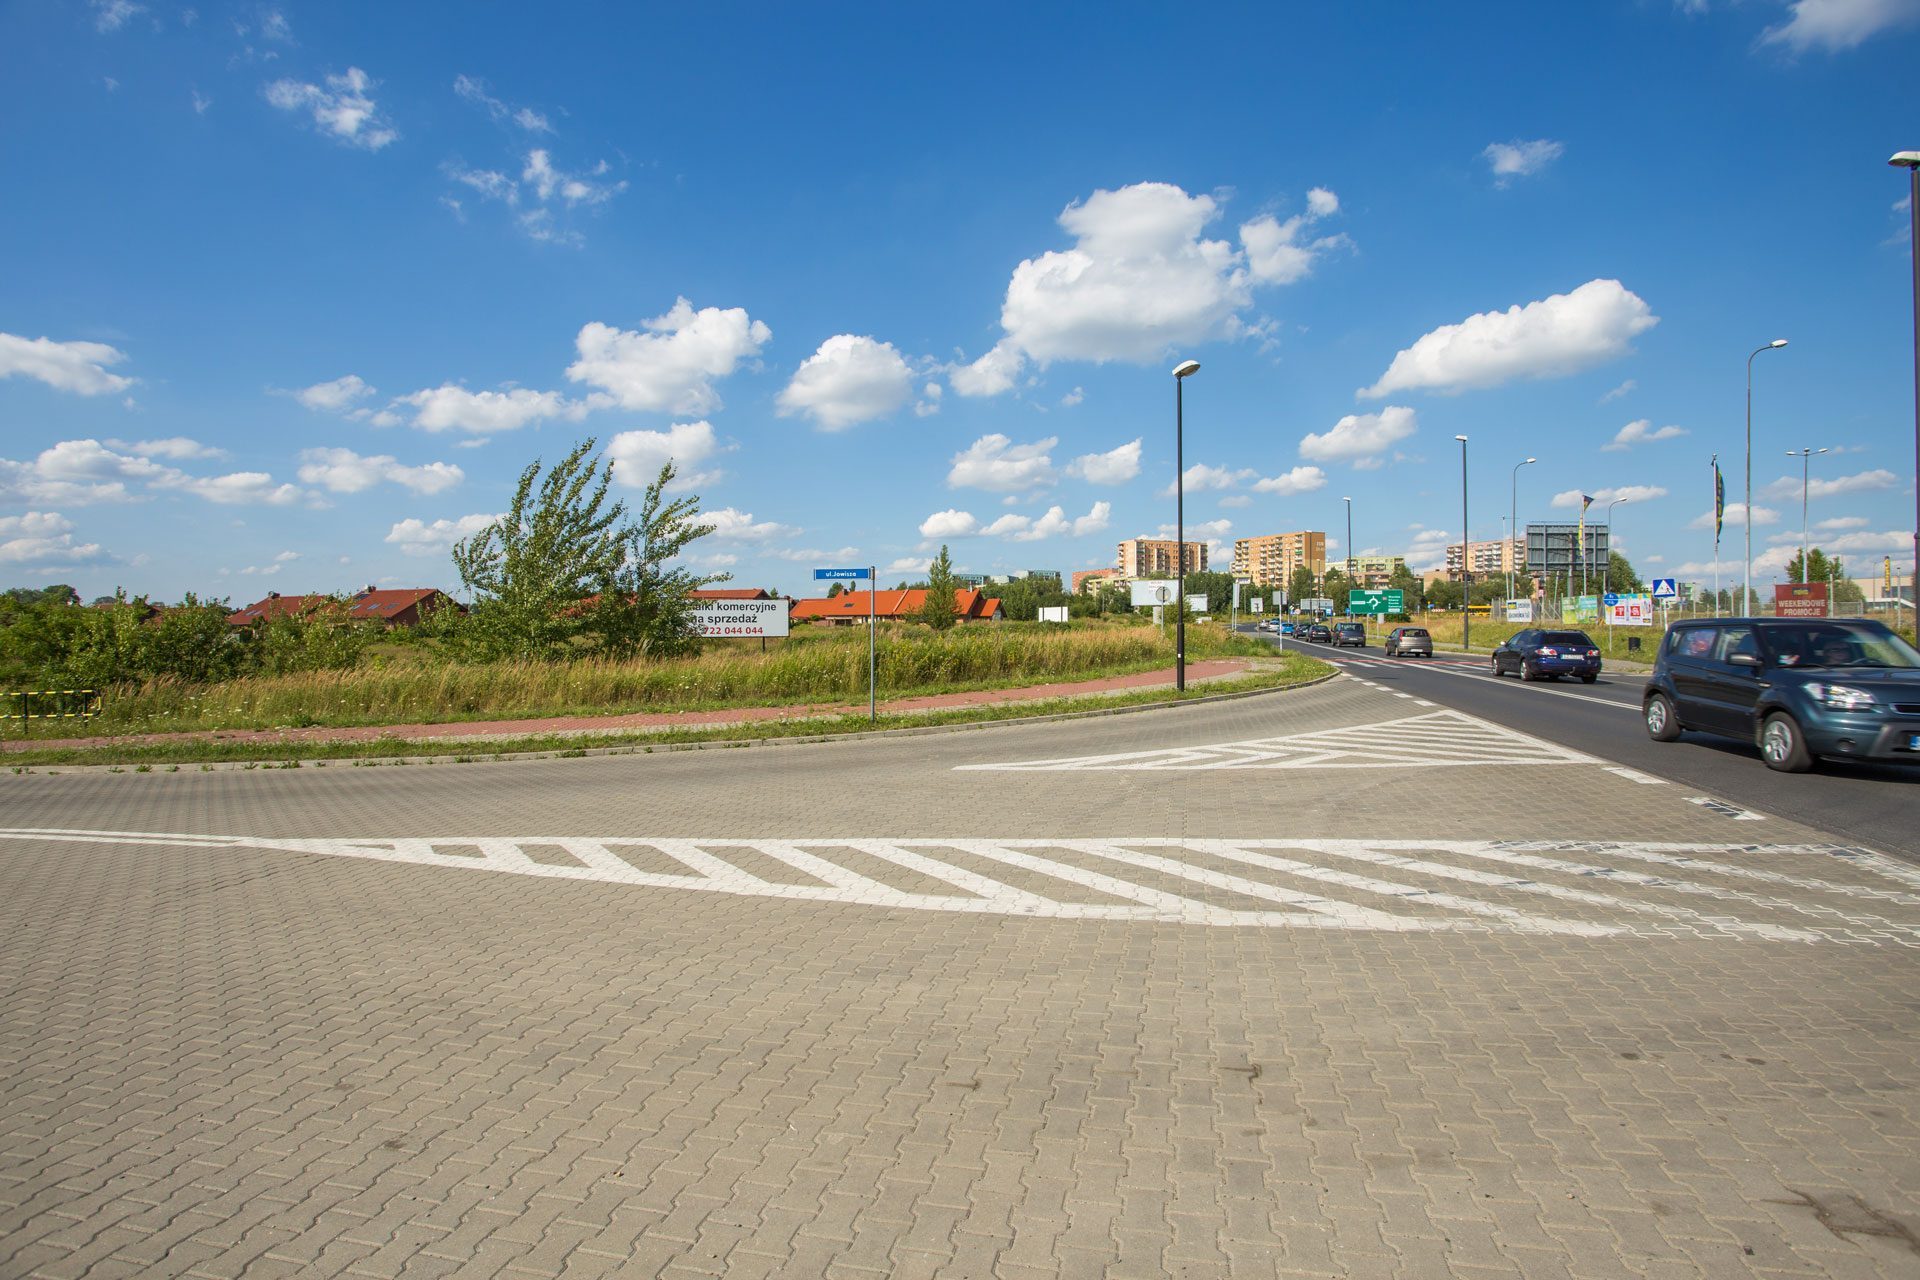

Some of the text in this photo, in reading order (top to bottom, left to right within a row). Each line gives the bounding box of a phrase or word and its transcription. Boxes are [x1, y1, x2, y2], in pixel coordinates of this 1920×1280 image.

[716, 602, 777, 613] komercyjne
[1778, 600, 1825, 608] WEEKENDOWE
[1784, 608, 1821, 616] PROMOCJE
[707, 613, 758, 625] sprzedaż
[703, 627, 764, 635] 722 044 044
